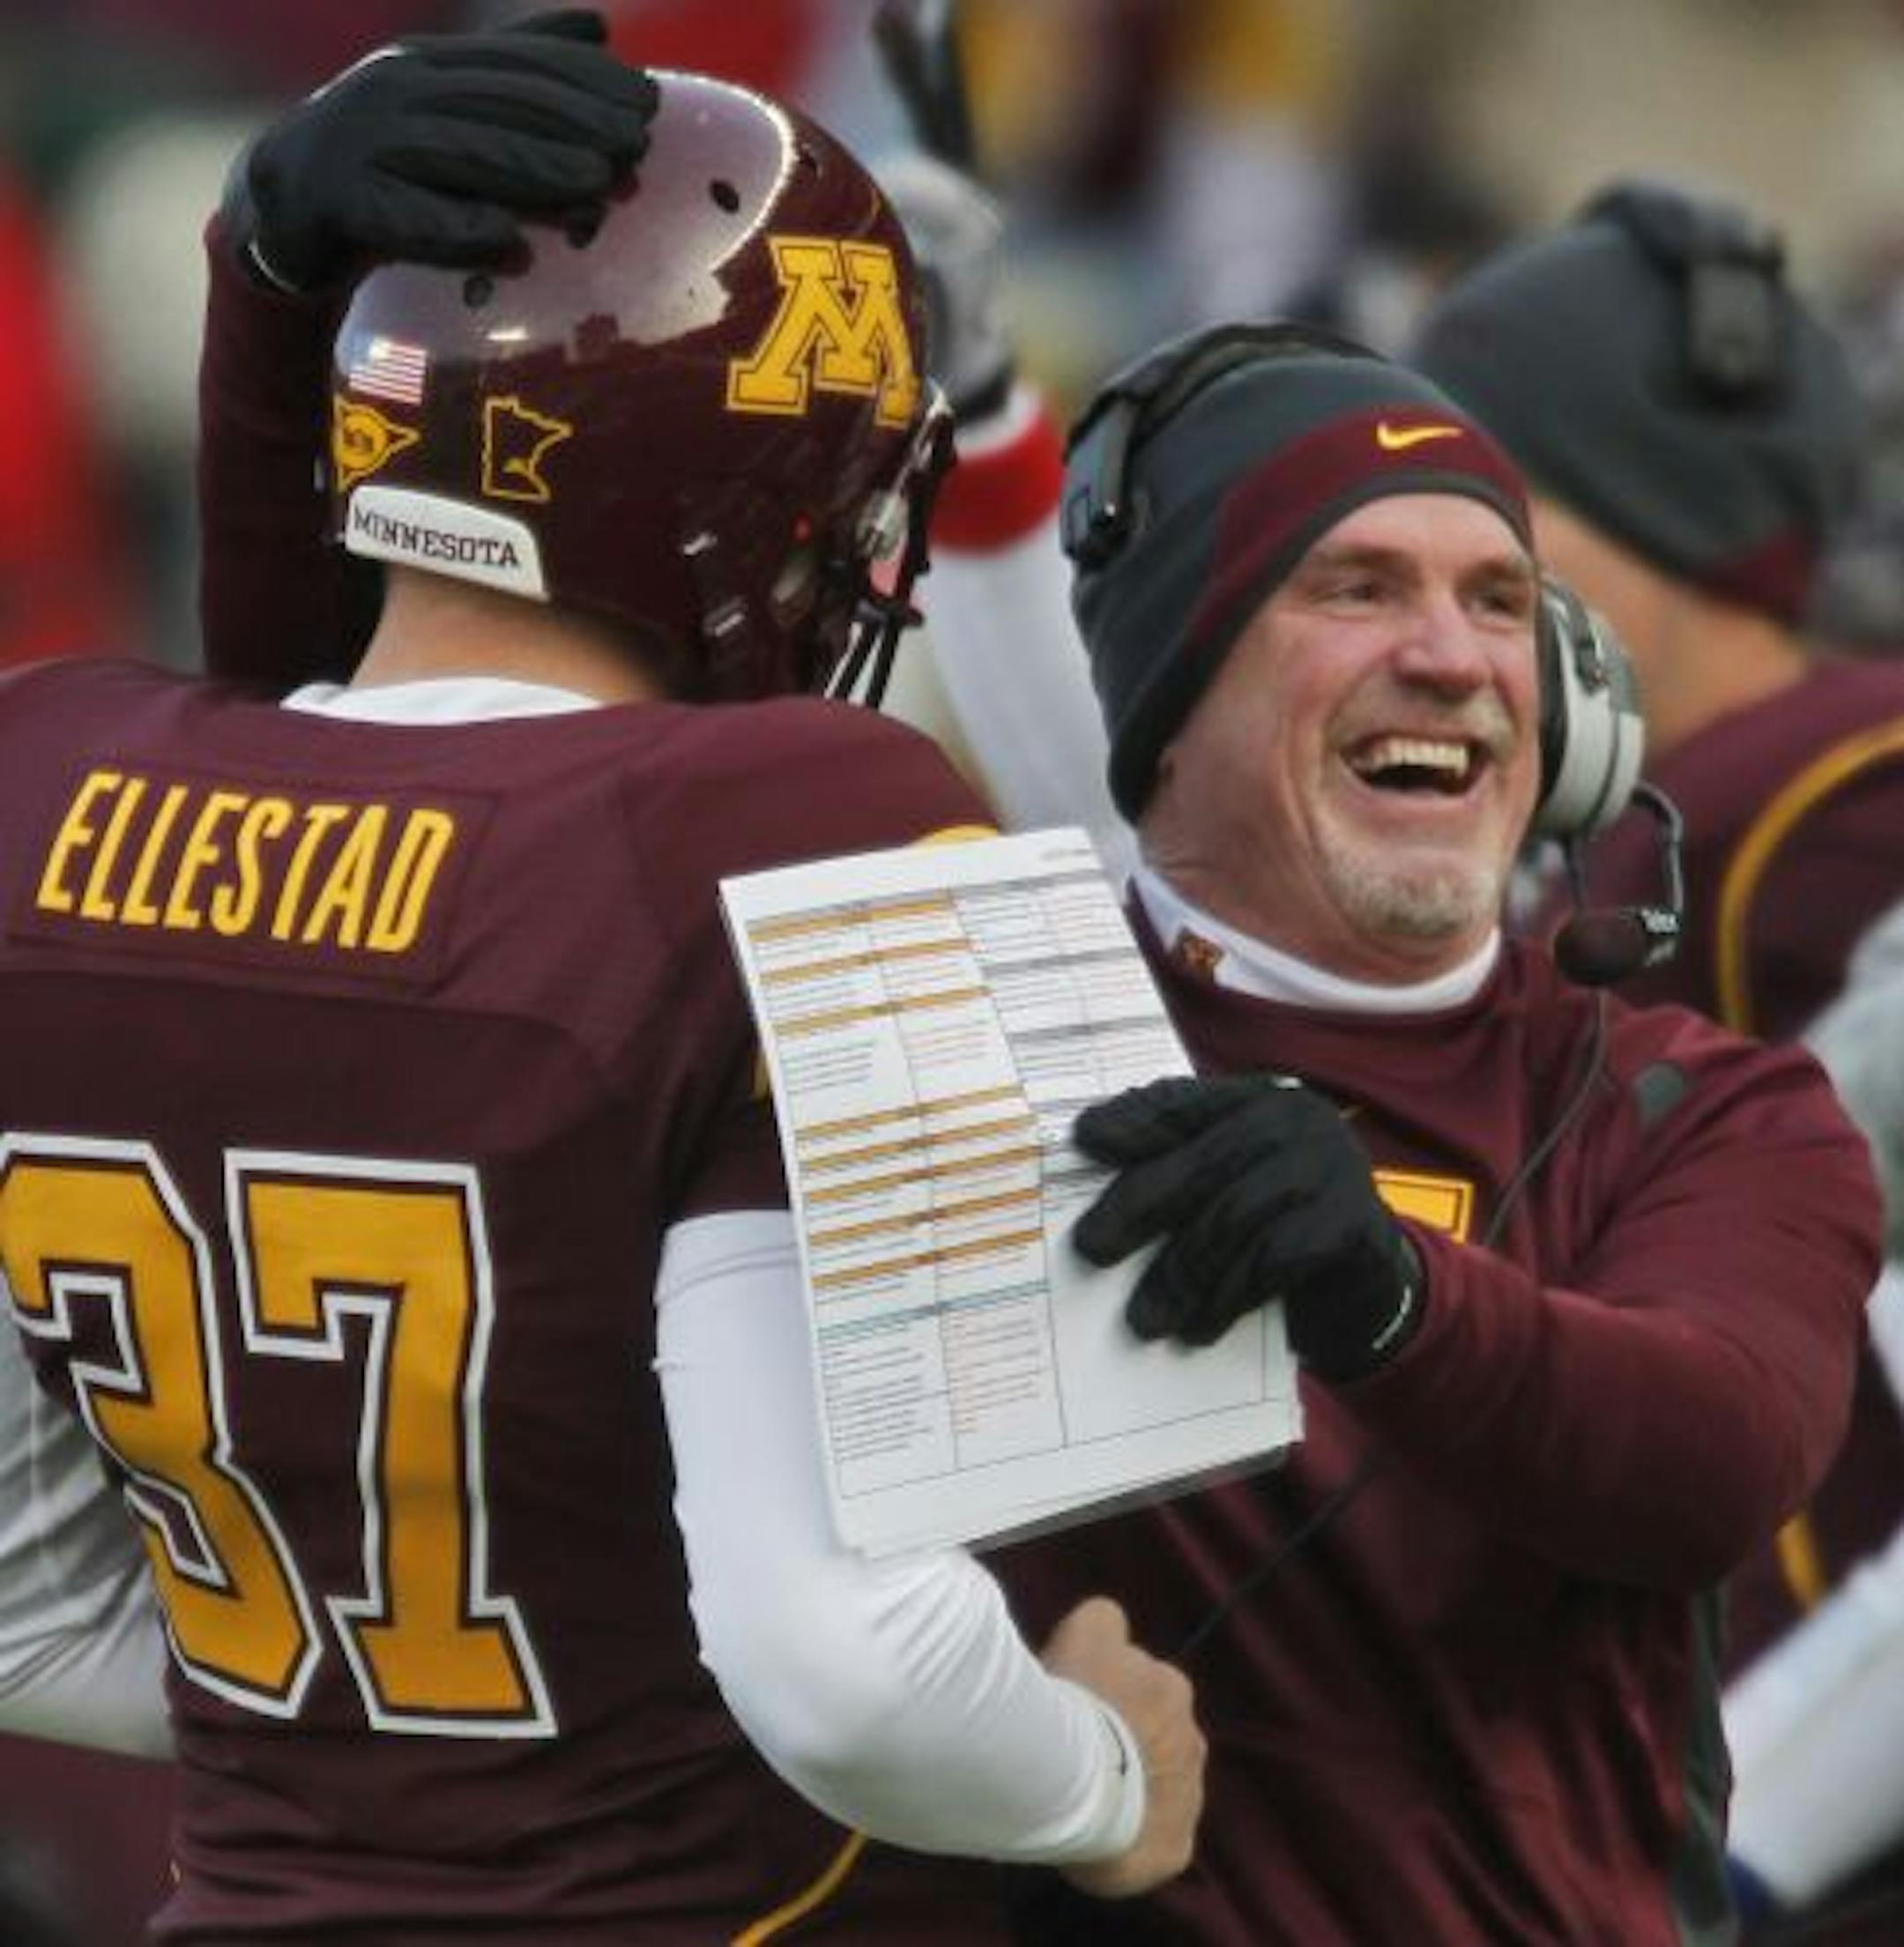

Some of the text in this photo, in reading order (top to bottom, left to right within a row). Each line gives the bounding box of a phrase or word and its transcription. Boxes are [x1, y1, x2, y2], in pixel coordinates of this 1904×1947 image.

[726, 238, 918, 427] M
[353, 505, 520, 568] MINNESOTA
[35, 767, 456, 954] ELLESTAD
[0, 1132, 558, 1739] 37
